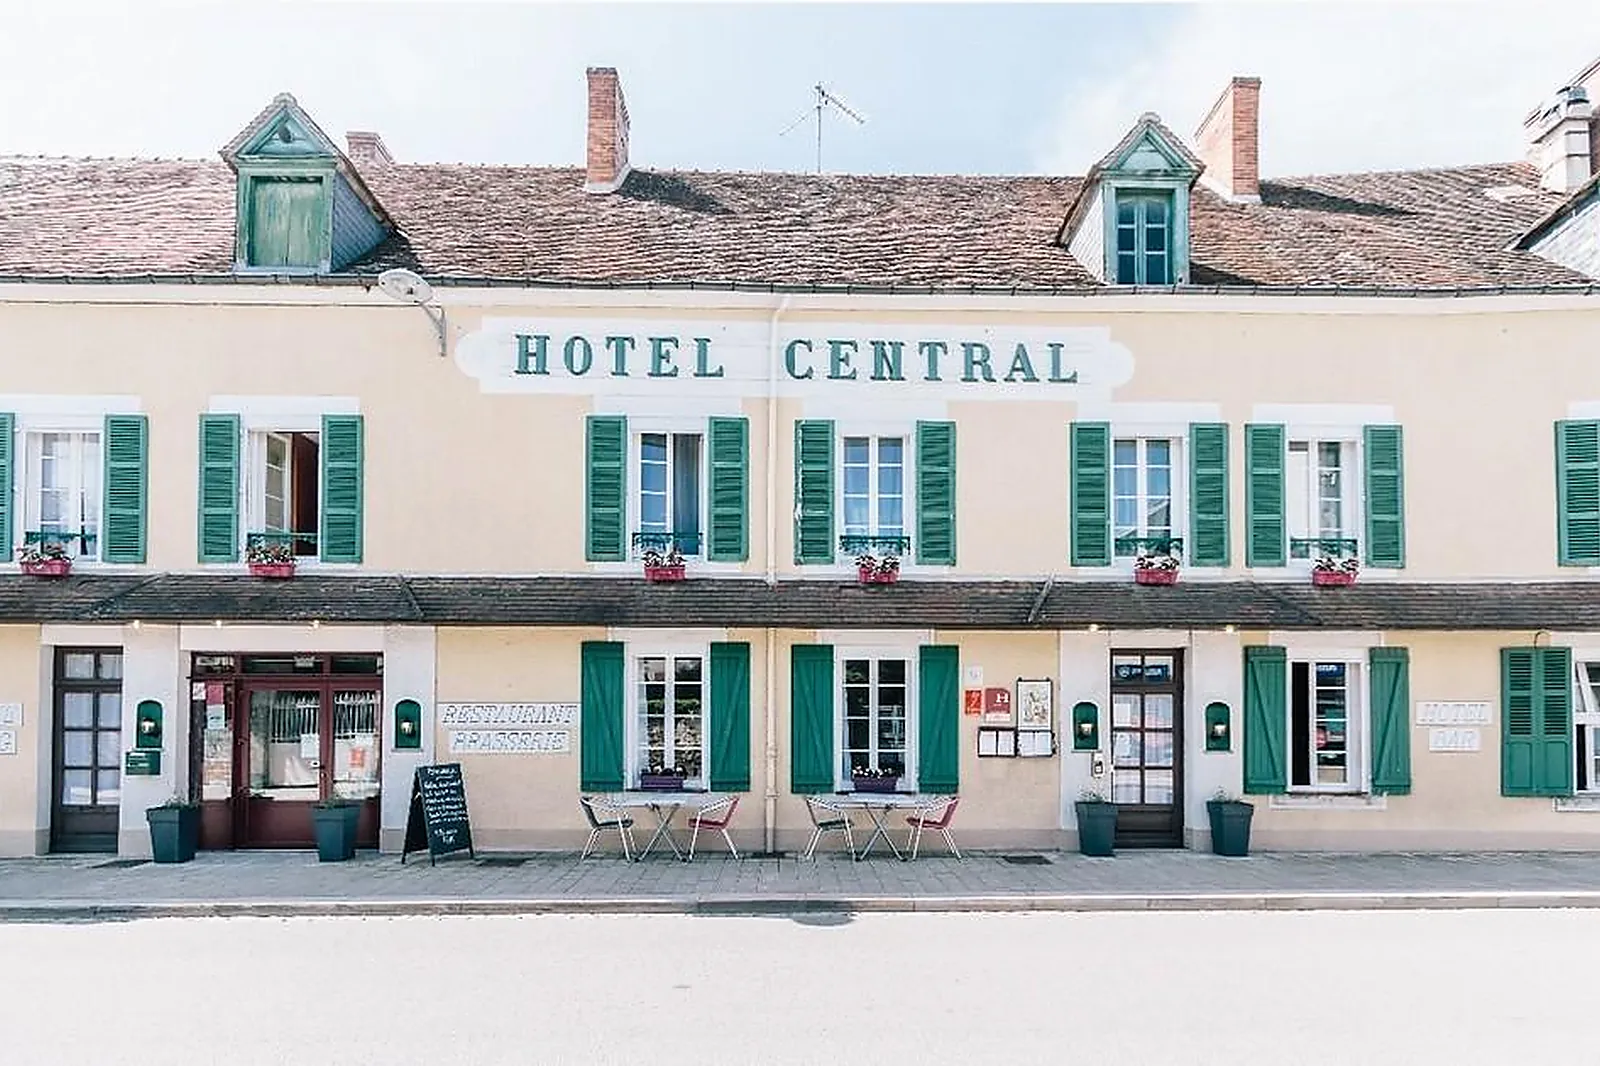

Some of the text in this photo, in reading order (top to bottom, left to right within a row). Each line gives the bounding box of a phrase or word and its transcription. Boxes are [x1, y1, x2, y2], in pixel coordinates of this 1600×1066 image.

[513, 333, 1079, 384] HOTEL CENTRAL
[995, 692, 1010, 703] H
[441, 703, 578, 724] RESTAURANT
